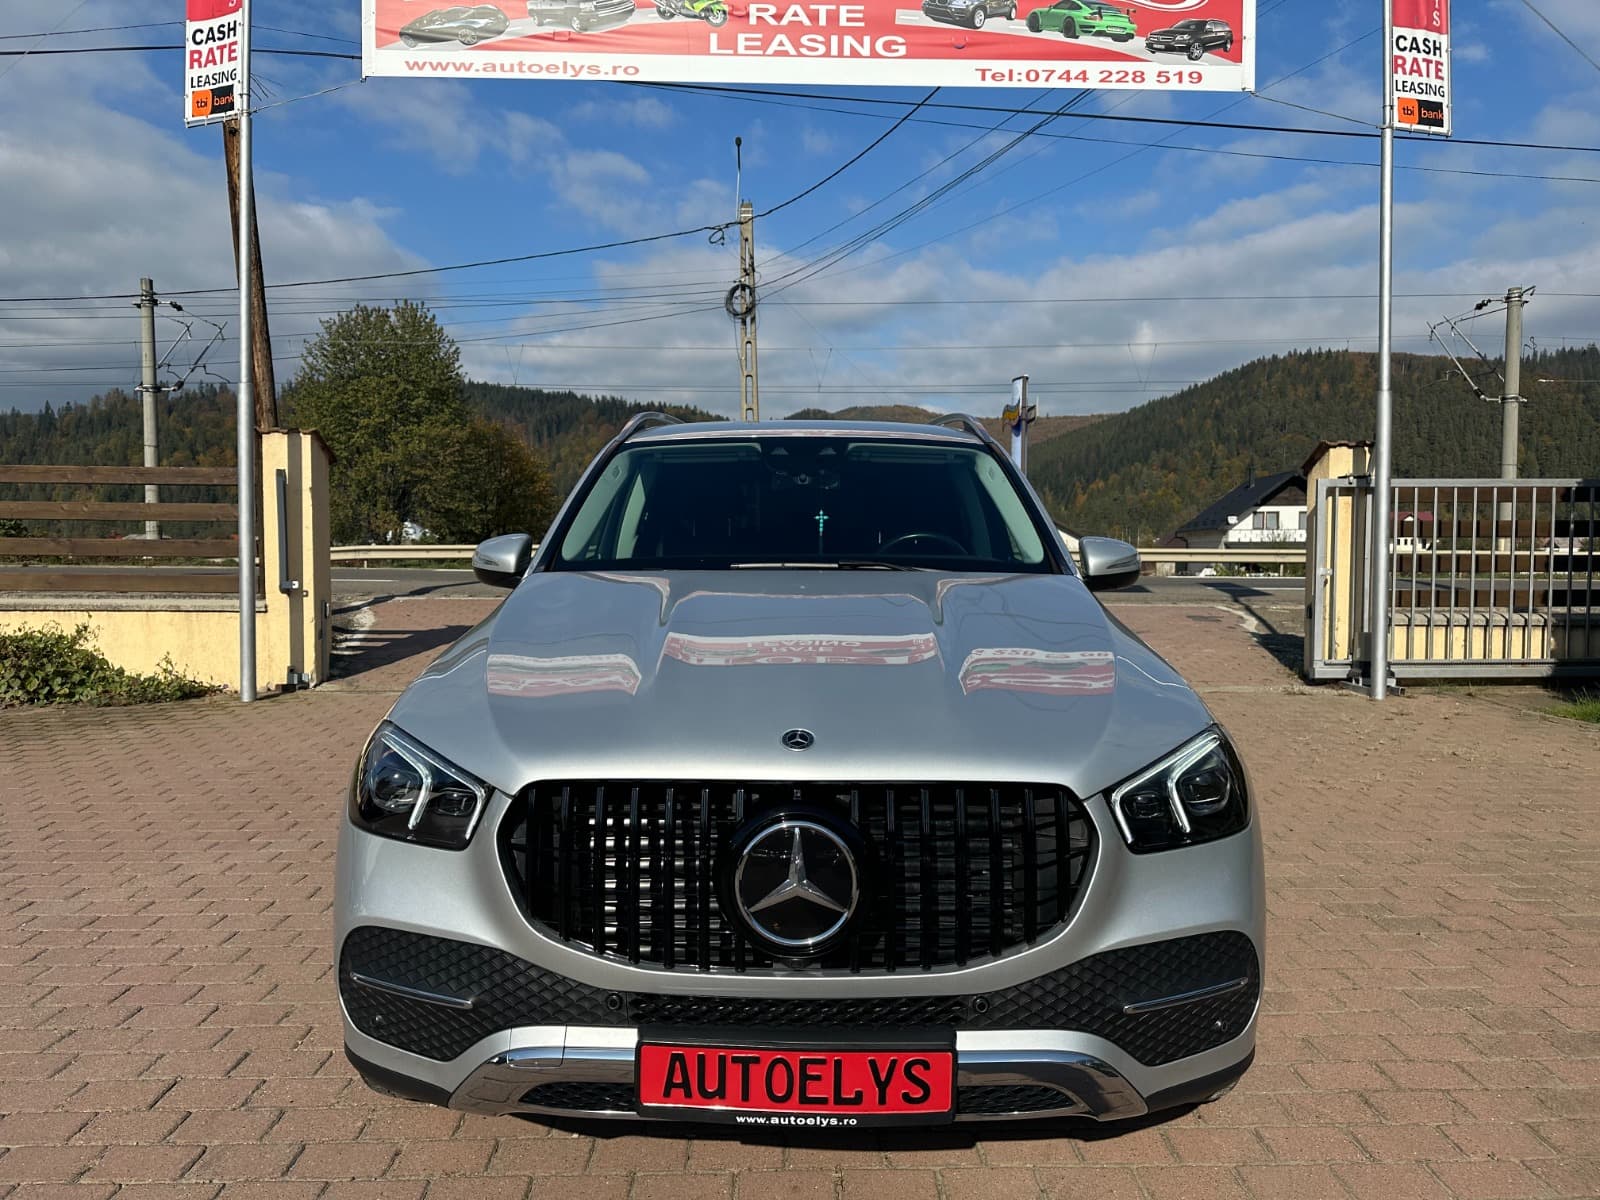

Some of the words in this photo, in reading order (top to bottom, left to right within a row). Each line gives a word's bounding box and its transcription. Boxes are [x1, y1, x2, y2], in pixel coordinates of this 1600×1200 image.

[749, 4, 865, 27] RATE
[191, 20, 237, 46] CASH
[189, 40, 238, 70] RATE
[709, 32, 907, 57] LEASING
[1395, 35, 1442, 58] CASH
[190, 68, 237, 88] LEASING
[404, 58, 640, 78] www.autoelys.ro
[975, 68, 1090, 83] Tel:0744
[1098, 70, 1146, 84] 228
[1156, 70, 1203, 84] 519
[1393, 54, 1445, 81] RATE
[1395, 79, 1445, 98] LEASING
[196, 97, 208, 109] tbi
[213, 94, 235, 106] bank
[1402, 106, 1415, 117] tbi
[1421, 107, 1443, 120] bank
[662, 1051, 931, 1105] AUTOELYS
[736, 1115, 857, 1127] www.autoelys.ro
